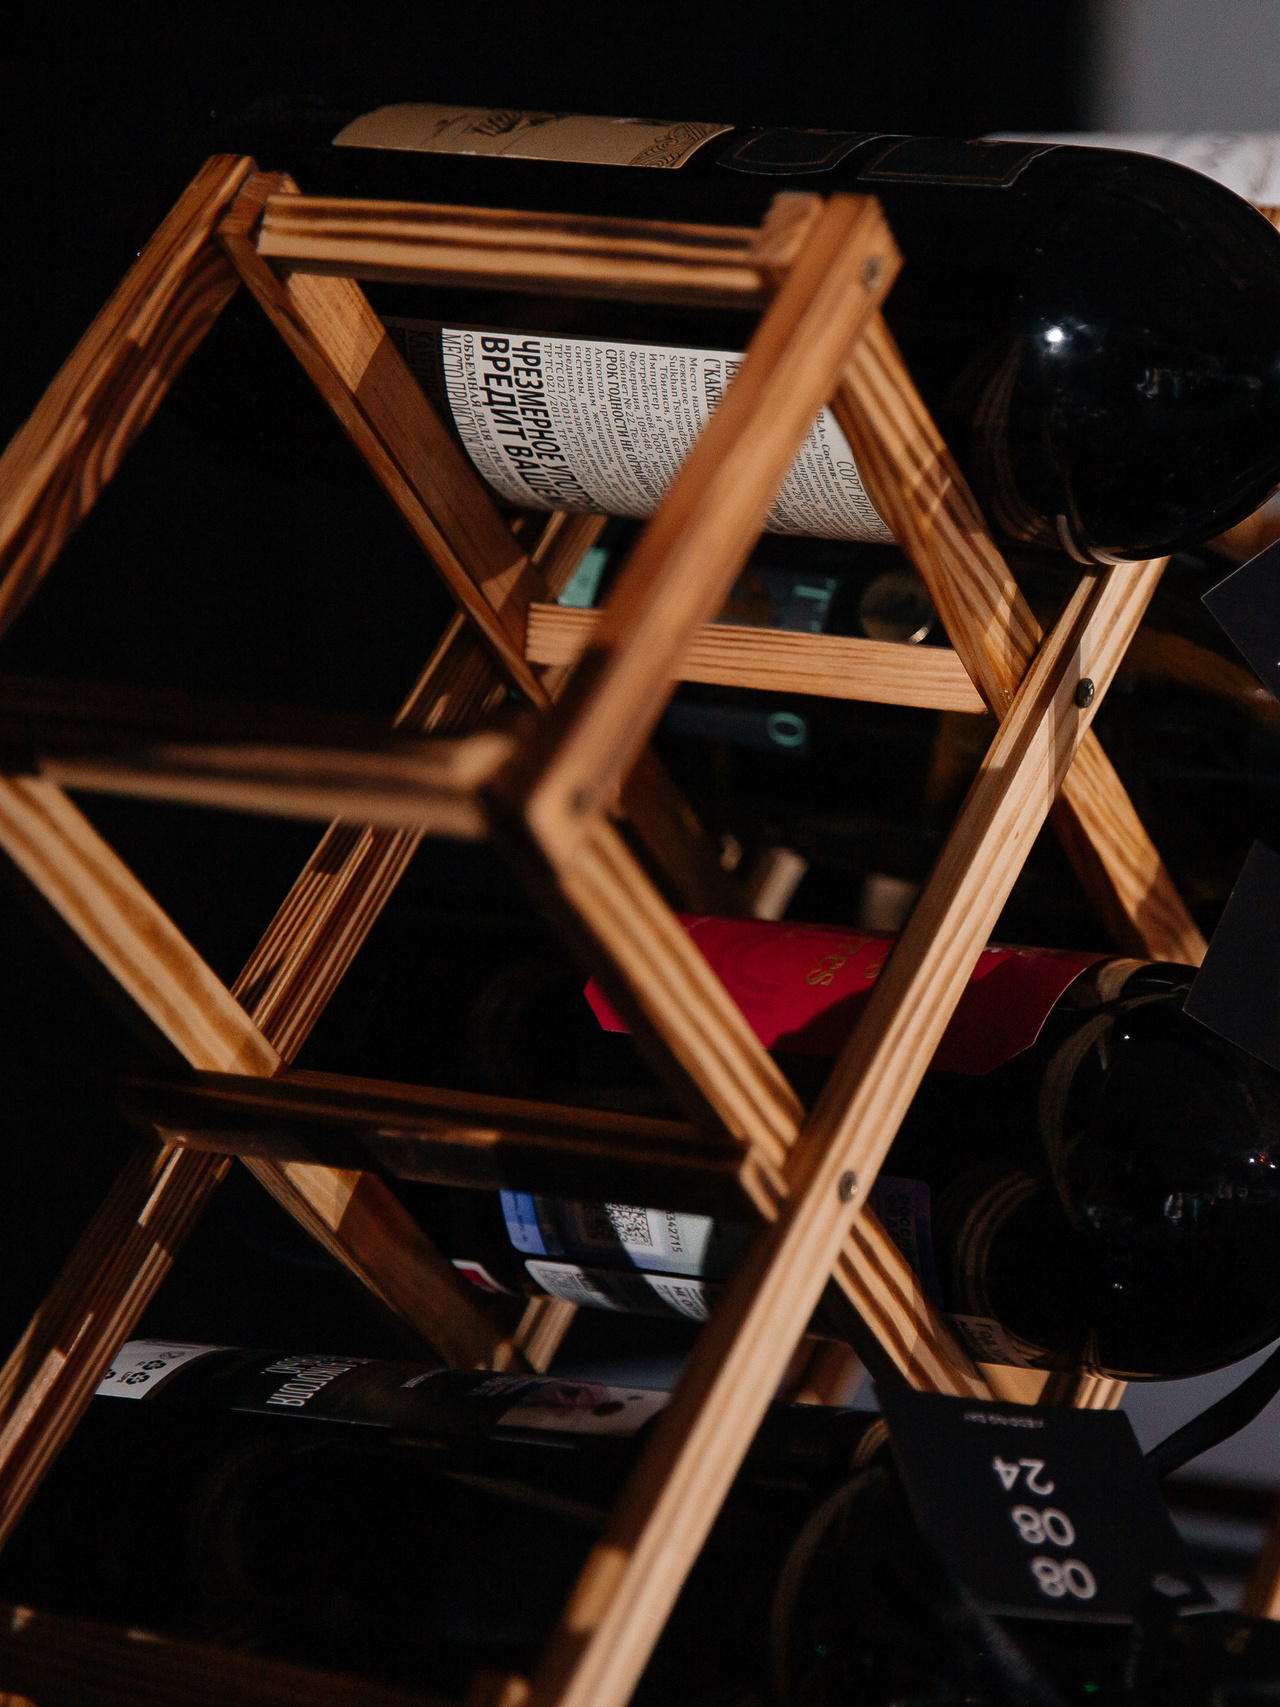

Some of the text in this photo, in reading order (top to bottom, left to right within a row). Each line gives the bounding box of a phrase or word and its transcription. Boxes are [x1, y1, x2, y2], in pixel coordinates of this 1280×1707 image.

[441, 334, 464, 378] МЕСТО
[544, 343, 552, 358] ТР
[545, 359, 553, 373] ТС
[555, 344, 563, 359] ТР
[556, 360, 564, 374] ТС
[564, 345, 576, 394] вредных
[605, 349, 619, 380] СРОК
[463, 334, 482, 407] ОБЪЕМНАЯ
[473, 410, 494, 441] ДОЛЯ
[479, 336, 528, 441] ВРЕДИТ
[595, 347, 605, 400] Алкоголь
[619, 349, 629, 396] кабинет
[659, 366, 672, 416] Тбилиси,
[669, 354, 679, 397] Sulkhan
[679, 356, 689, 405] нежилое
[689, 357, 698, 392] Место
[511, 341, 566, 462] ЧРЕЗМЕРНОЕ
[545, 375, 563, 427] 021/2011,
[556, 375, 573, 425] 021/2011
[568, 394, 579, 414] для
[575, 345, 585, 397] системы,
[581, 402, 594, 435] почек,
[591, 439, 609, 470] печени
[584, 347, 597, 407] кормящим
[591, 411, 614, 465] женщинам,
[607, 382, 630, 437] ГОДНОСТИ
[622, 398, 632, 410] №
[625, 411, 635, 426] 22.
[628, 351, 641, 412] Федерация,
[637, 416, 652, 451] 109548,
[638, 352, 655, 432] потребителей:
[650, 433, 664, 454] ООО
[648, 353, 660, 410] Импортер
[657, 427, 681, 476] организац
[557, 428, 568, 441] ТР
[569, 434, 580, 447] ТР
[573, 415, 594, 458] здоровья
[599, 404, 632, 479] противопоказан
[664, 420, 675, 433] ул.
[672, 399, 688, 446] Tsinsadze
[562, 441, 573, 453] ТС
[574, 448, 585, 459] ТС
[620, 440, 635, 452] НЕ
[836, 461, 863, 493] СОРТ
[993, 1456, 1055, 1496] 24
[1012, 1504, 1076, 1547] 08
[1031, 1556, 1097, 1599] 08
